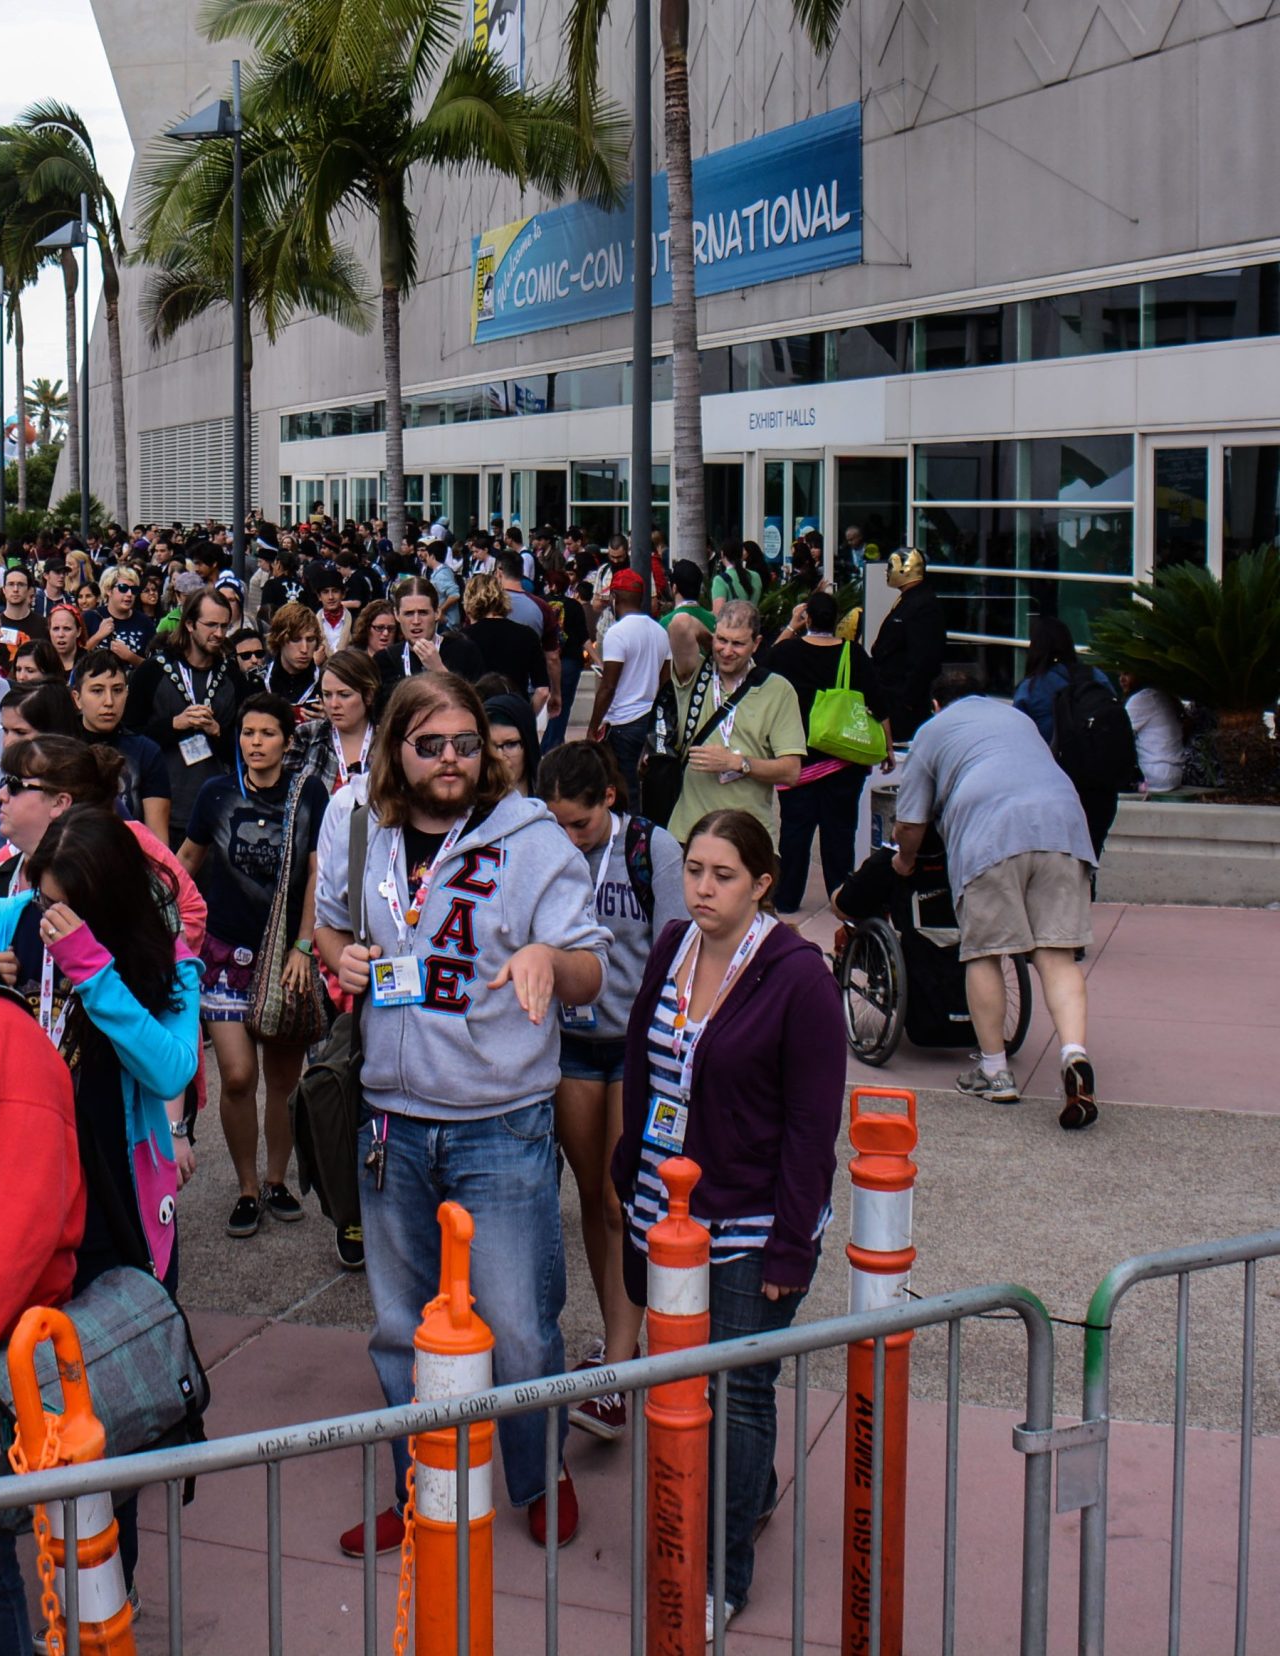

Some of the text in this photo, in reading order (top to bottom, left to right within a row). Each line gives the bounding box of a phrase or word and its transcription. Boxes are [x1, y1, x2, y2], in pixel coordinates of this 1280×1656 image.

[514, 179, 851, 307] COMIC-CON TRNATIONAL
[749, 407, 816, 430] EXHIBIT HALLS
